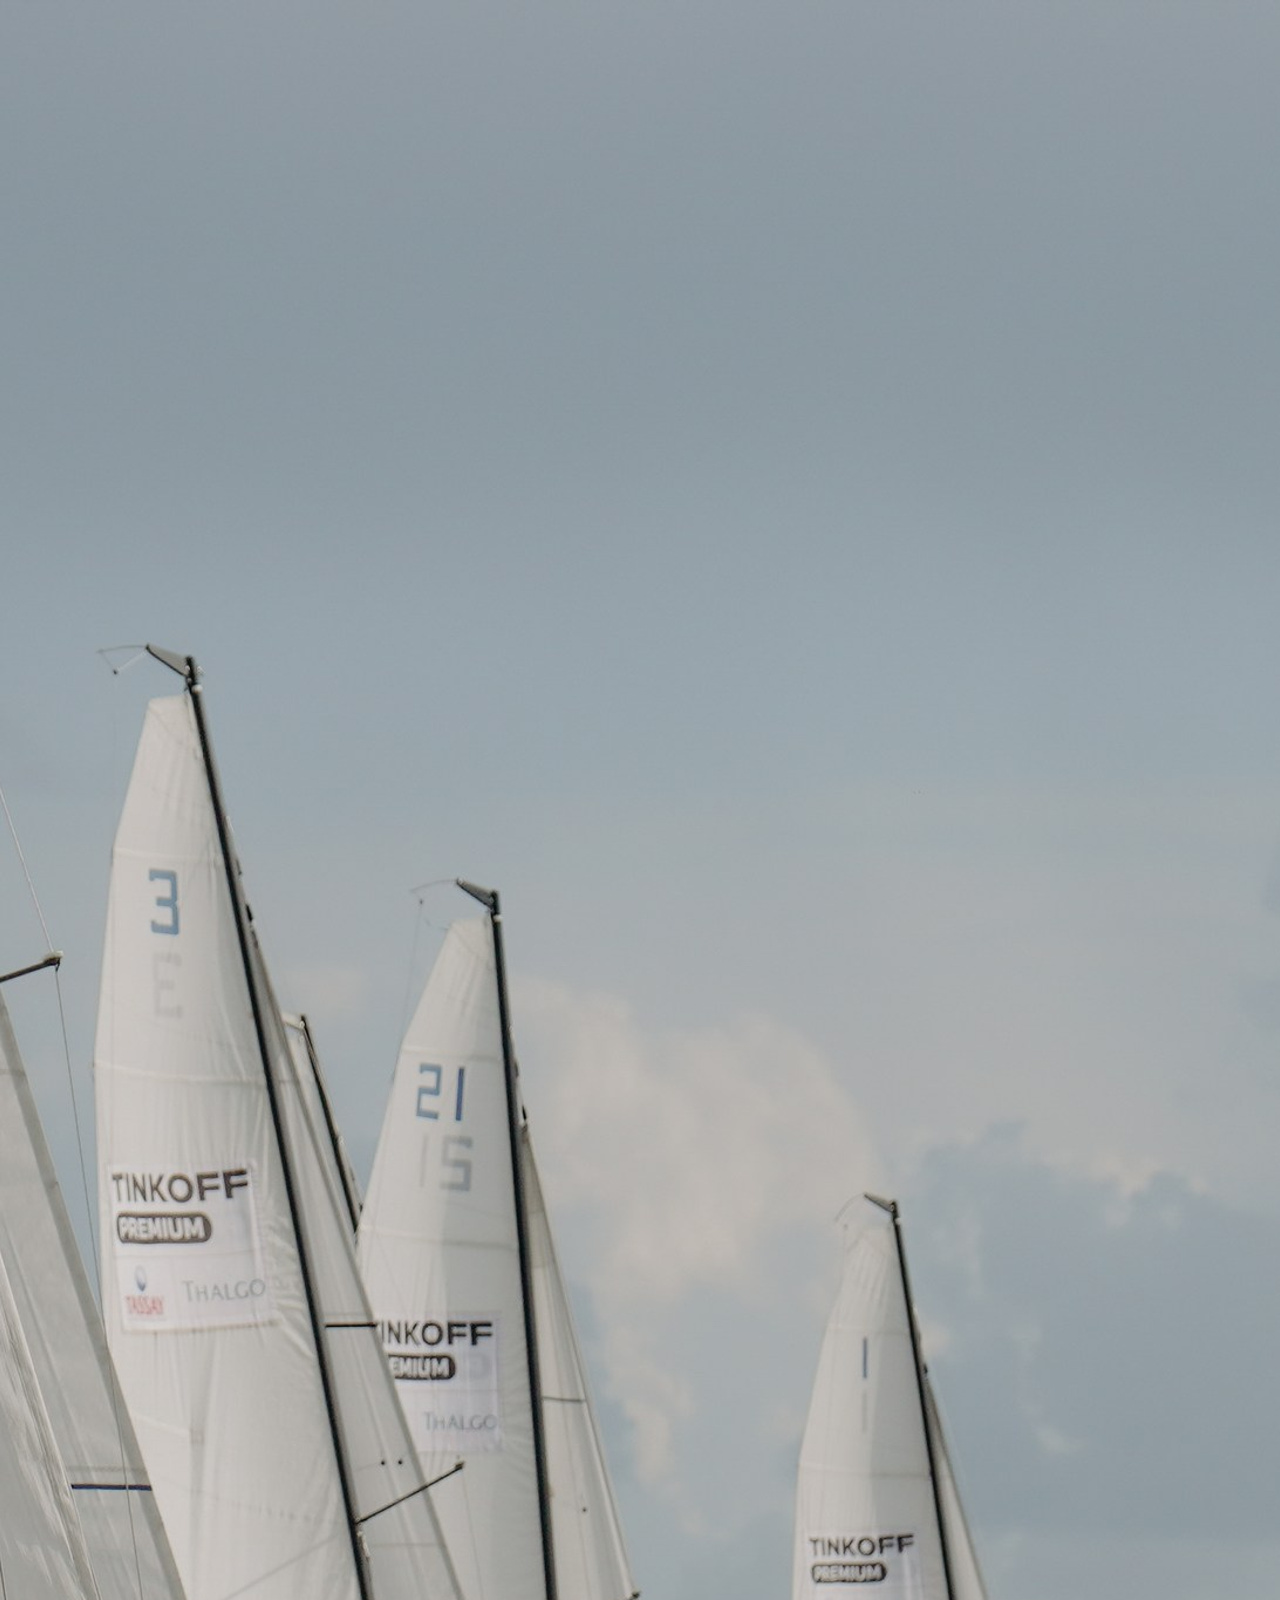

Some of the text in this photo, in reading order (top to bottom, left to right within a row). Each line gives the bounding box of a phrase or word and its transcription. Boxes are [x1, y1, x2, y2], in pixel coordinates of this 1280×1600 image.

[149, 869, 179, 935] 3
[416, 1062, 465, 1121] 21
[113, 1168, 248, 1203] TINKOFF
[120, 1216, 206, 1242] PREMIUM
[182, 1278, 267, 1303] THALGO
[379, 1320, 492, 1346] INKOFF
[389, 1357, 450, 1378] EMIUM
[810, 1533, 914, 1556] TINKOFF
